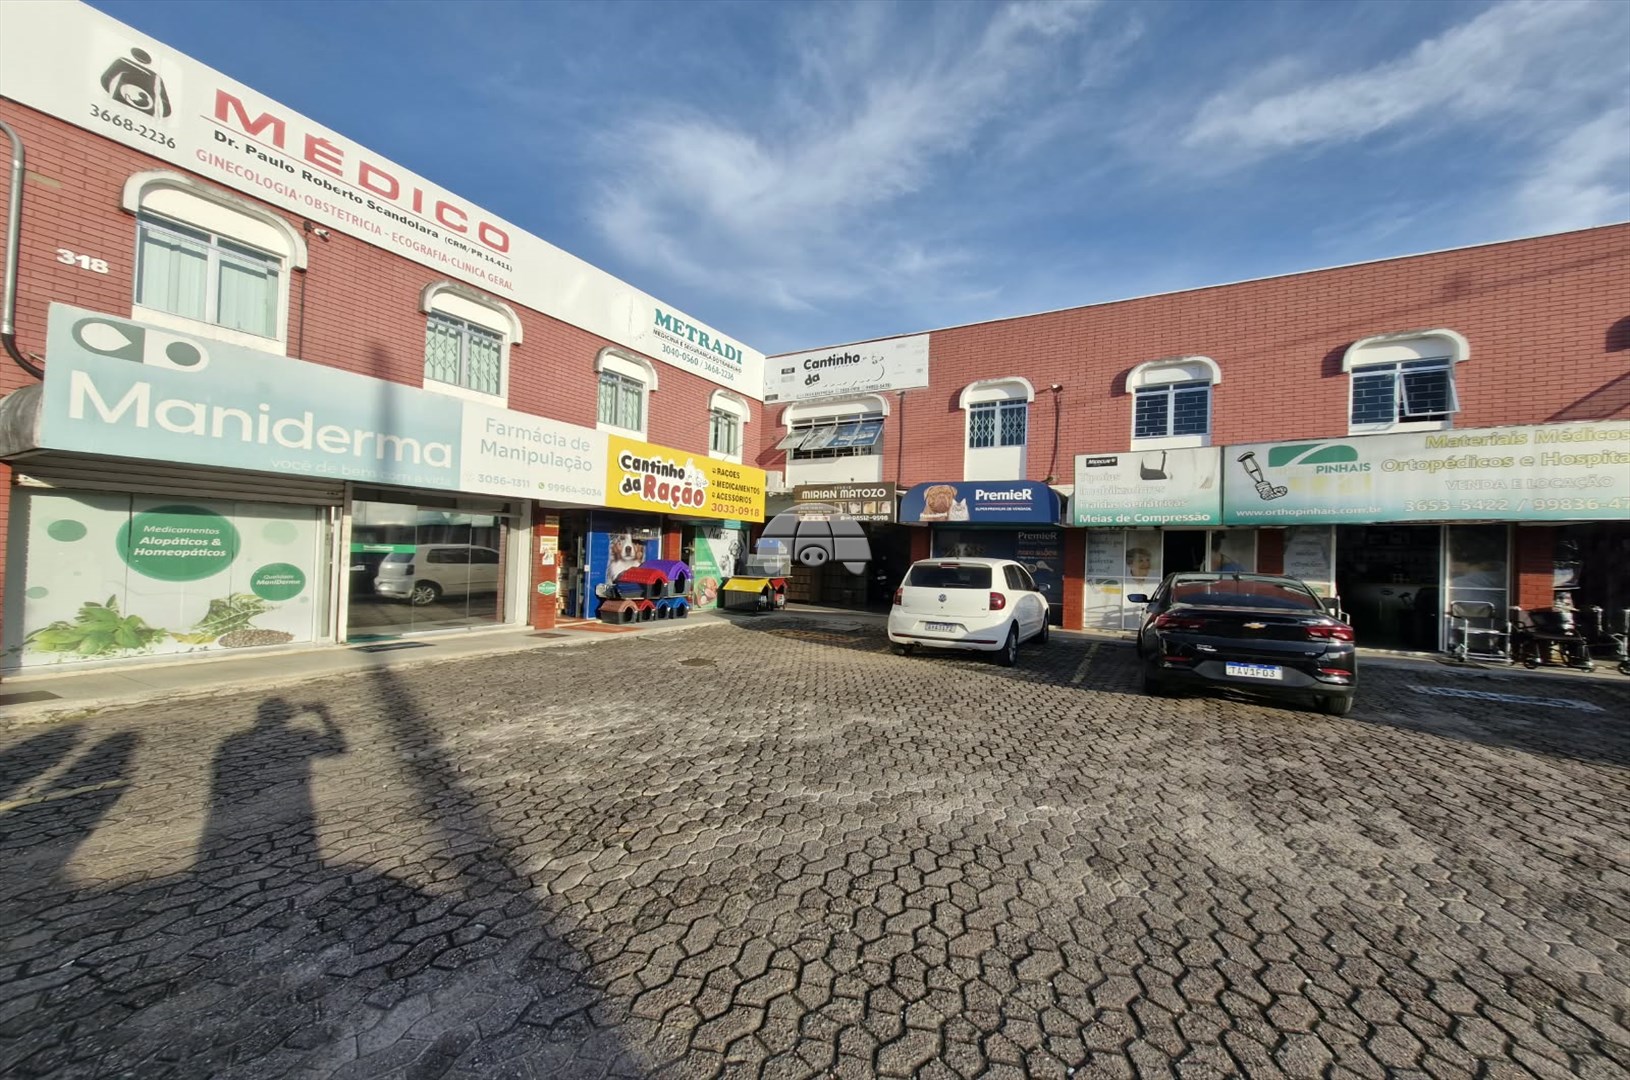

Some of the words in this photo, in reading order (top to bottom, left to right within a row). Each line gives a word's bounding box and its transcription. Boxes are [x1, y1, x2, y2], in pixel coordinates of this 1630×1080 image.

[90, 104, 176, 149] 3668-2236
[214, 88, 510, 252] MÉDICO
[214, 130, 239, 149] Dr.
[245, 144, 295, 174] Paulo
[302, 170, 363, 204] Roberto
[367, 200, 439, 238] Scandolara
[445, 237, 483, 258] (CRM/PR
[56, 248, 110, 274] 318
[488, 273, 514, 291] GERAL
[654, 308, 743, 365] METRADI
[661, 343, 699, 366] 3040-0560
[803, 352, 860, 370] Cantinho
[804, 372, 820, 386] da
[68, 369, 453, 469] Maniderma
[485, 417, 567, 448] Farmácia
[570, 437, 591, 452] de
[1425, 430, 1529, 449] Materiais
[1534, 427, 1630, 444] Médicos
[480, 438, 593, 473] Manipulação
[1381, 454, 1514, 474] Ortopédicos
[1520, 455, 1535, 466] e
[270, 458, 313, 472] você
[316, 462, 338, 474] de
[620, 454, 686, 480] Cantinho
[1316, 463, 1371, 474] PINHAIS
[477, 473, 530, 489] 3056-1311
[716, 480, 760, 495] MEDICAMENTOS
[1445, 478, 1507, 490] VENDA
[1511, 477, 1523, 490] E
[1526, 473, 1615, 490] LOCAÇÃO
[622, 477, 642, 493] da
[643, 474, 704, 507] Ração
[801, 489, 837, 499] MIRIAN
[840, 488, 887, 498] MATOZO
[1236, 505, 1382, 517] www.orthopinhais.com.br
[1404, 498, 1509, 513] 3653-5422
[1079, 513, 1113, 523] Meias
[1116, 513, 1131, 523] de
[1134, 512, 1211, 524] Compressão
[143, 525, 220, 535] Medicamentos
[138, 536, 209, 546] Alopáticos
[211, 538, 222, 546] &
[133, 547, 226, 557] Homeopáticos
[1230, 666, 1276, 678] TAV1F03
